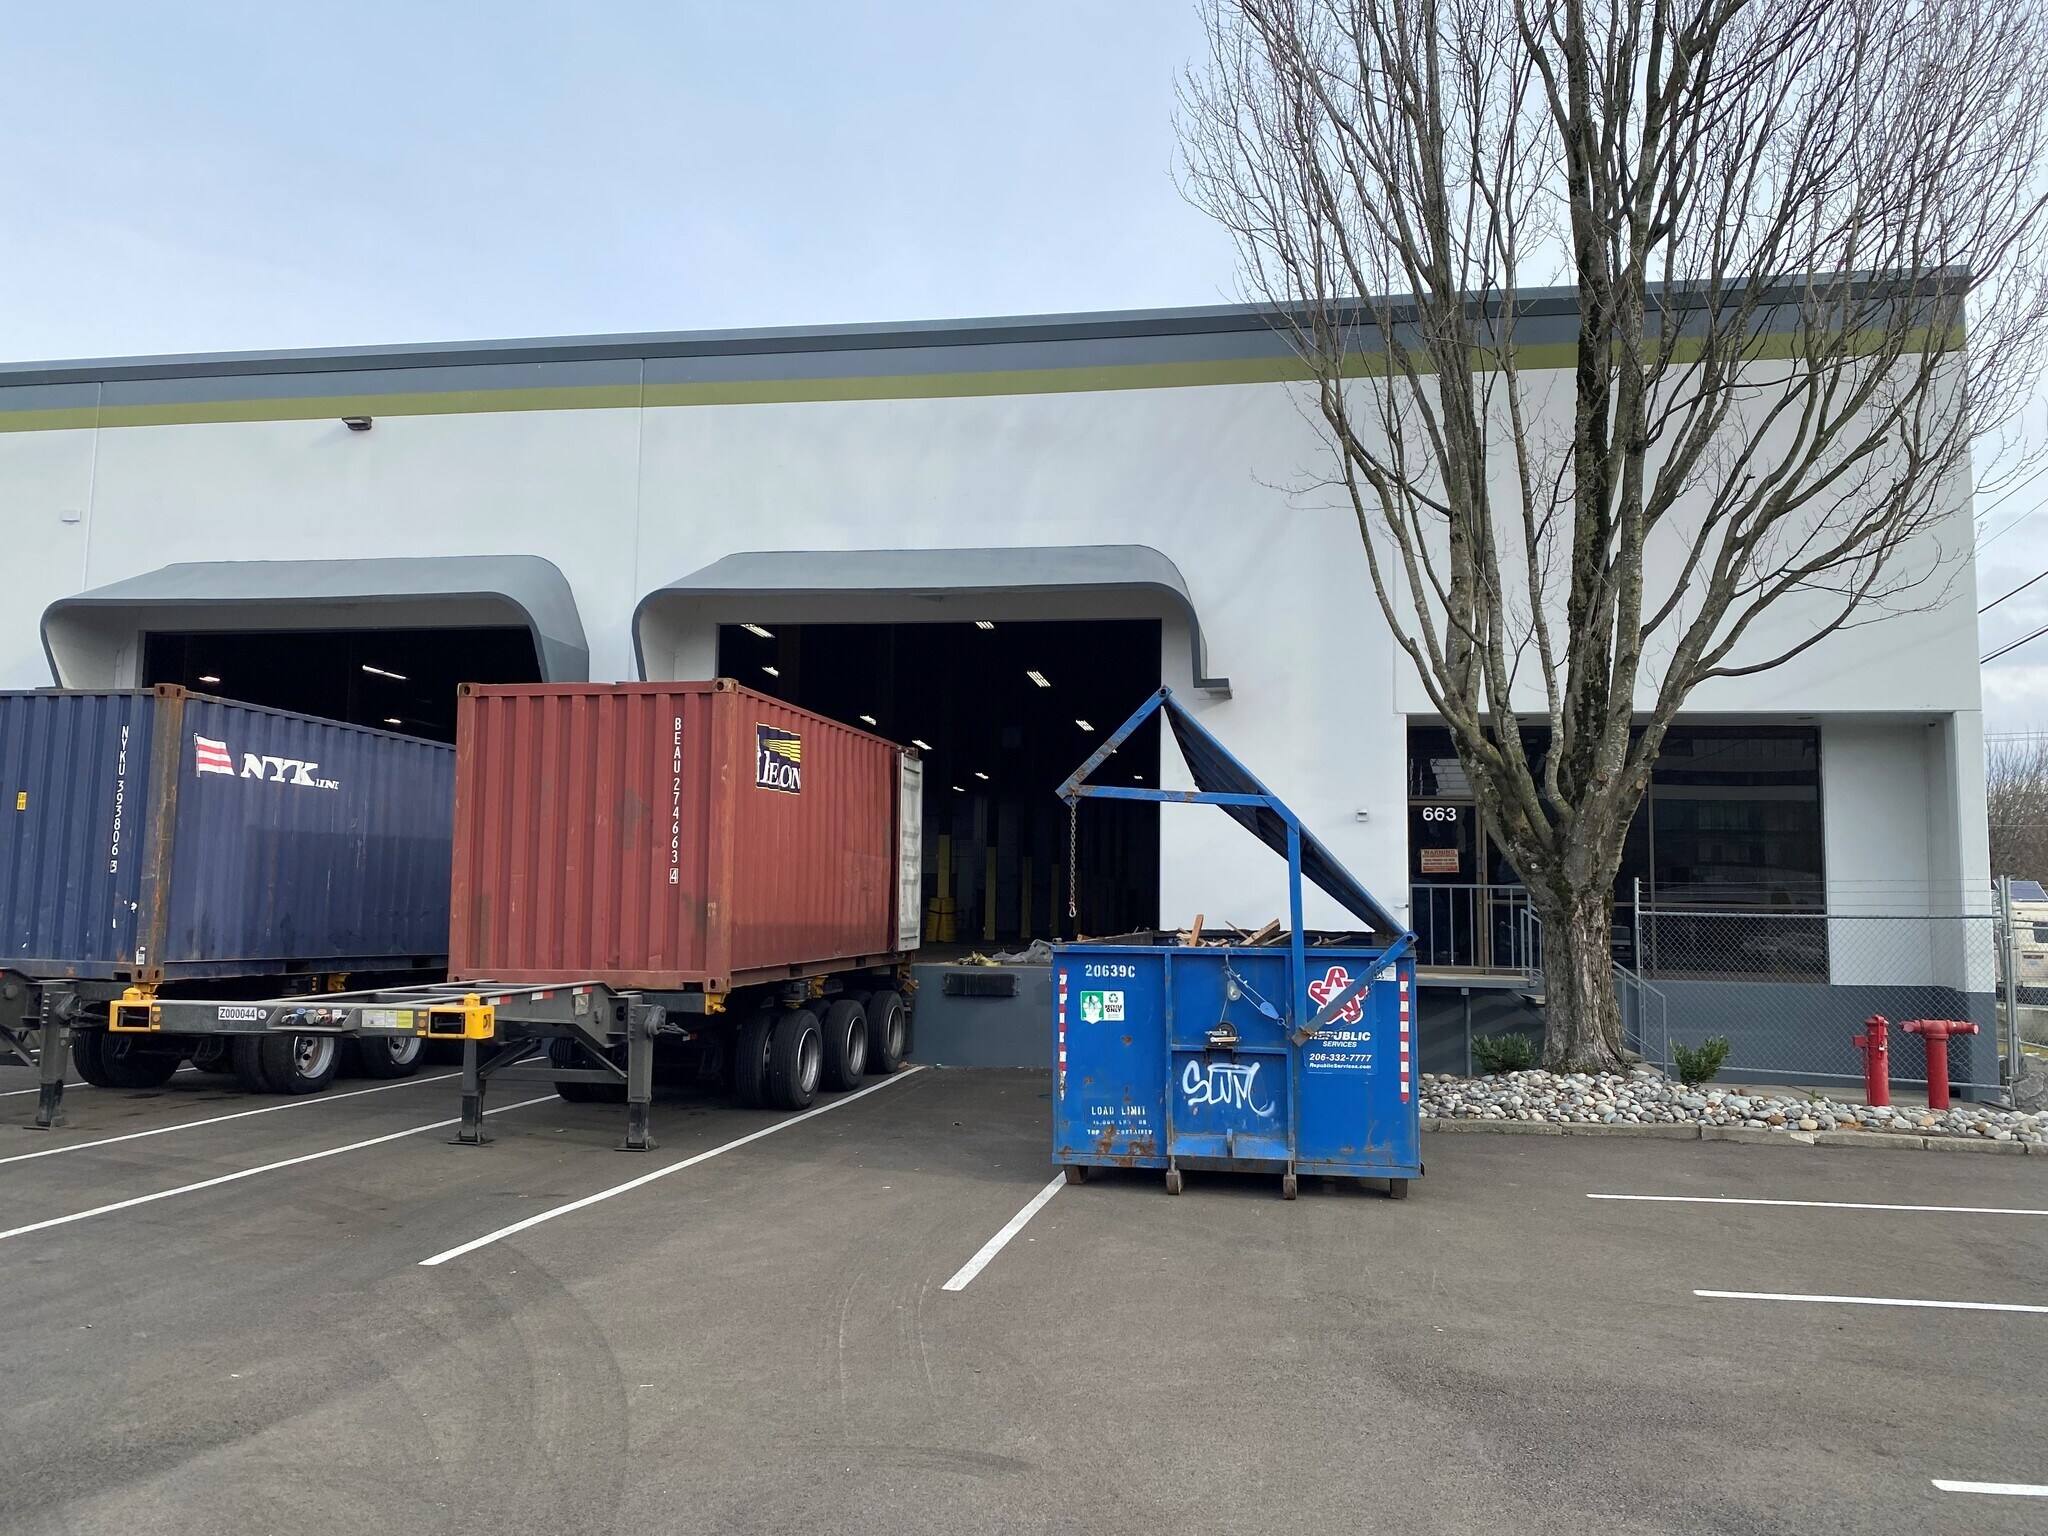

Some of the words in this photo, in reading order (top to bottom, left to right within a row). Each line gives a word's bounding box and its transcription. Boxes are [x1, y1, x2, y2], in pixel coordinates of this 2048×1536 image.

[118, 725, 129, 776] NYKU
[673, 717, 682, 774] BEAU
[240, 752, 319, 787] NYK
[111, 780, 124, 856] 393806
[671, 777, 680, 863] 274663
[1422, 806, 1457, 821] 663
[110, 860, 117, 873] 3
[670, 868, 678, 884] 4
[1085, 964, 1136, 978] 20639C
[219, 1008, 255, 1019] Z000044
[1322, 1040, 1357, 1048] SERVICES
[1309, 1053, 1372, 1062] 206-332-7777
[1091, 1105, 1115, 1116] LOAD
[1121, 1105, 1146, 1116] LIMIT
